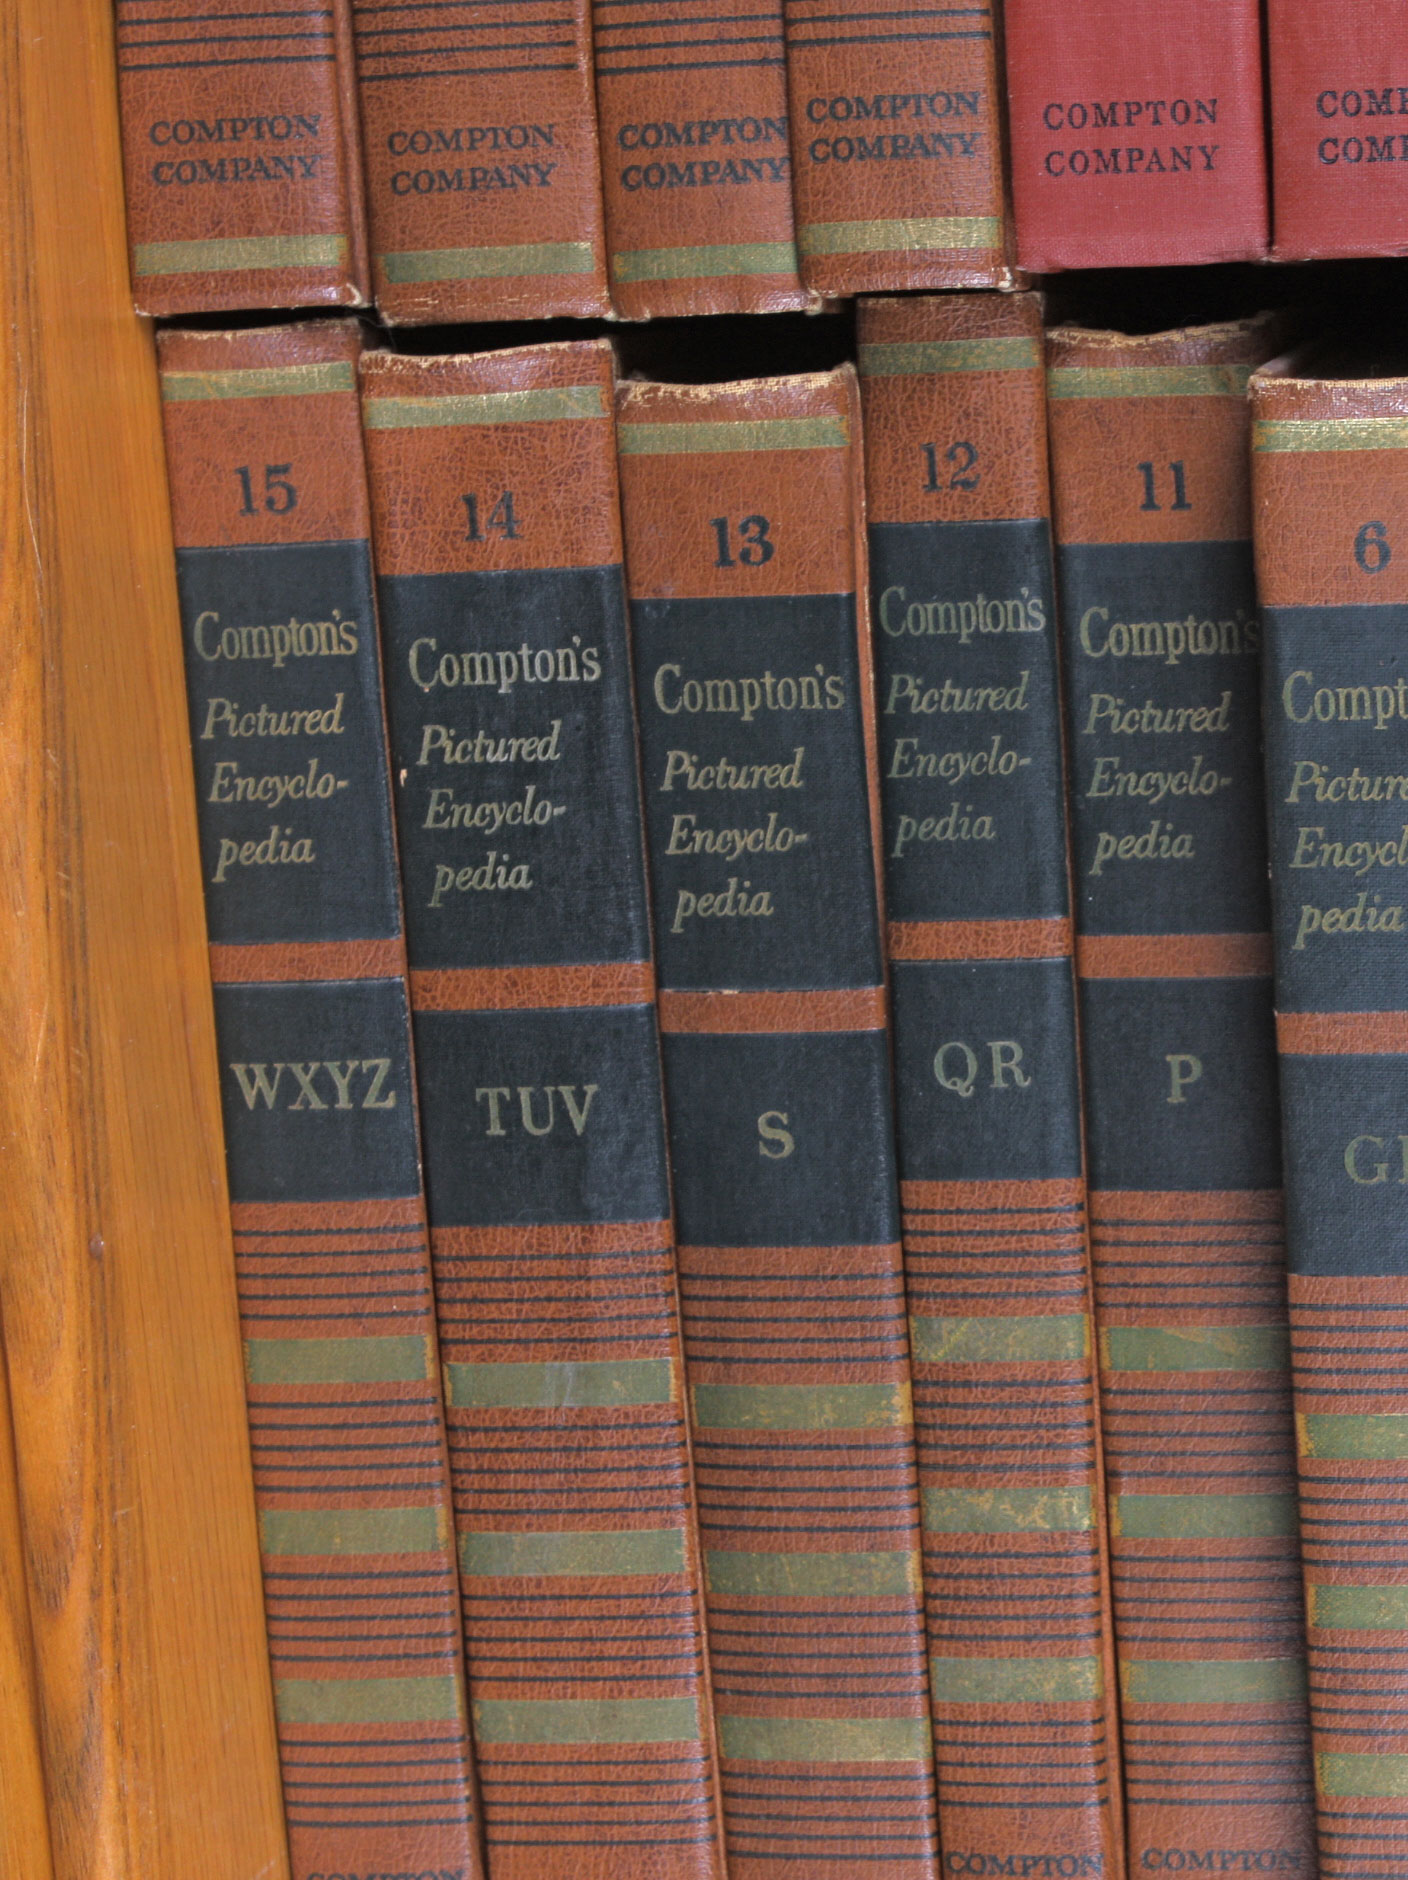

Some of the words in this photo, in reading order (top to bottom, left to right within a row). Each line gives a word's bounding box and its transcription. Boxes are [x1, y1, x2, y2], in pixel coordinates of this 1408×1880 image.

[148, 113, 321, 147] COMPTON
[805, 91, 981, 123] COMPTON
[1042, 98, 1219, 130] COMPTON
[387, 123, 555, 157] COMPTON
[617, 117, 788, 150] COMPTON
[808, 132, 982, 164] COMPANY
[152, 154, 320, 186] COMPANY
[390, 162, 557, 196] COMPANY
[621, 156, 791, 191] COMPANY
[1043, 144, 1220, 176] COMPANY
[235, 463, 297, 516] 15
[921, 441, 979, 492] 12
[1137, 461, 1193, 512] 11
[461, 490, 522, 541] 14
[709, 515, 774, 568] 13
[1353, 520, 1392, 575] 6
[194, 609, 358, 667] Compton's
[878, 586, 1046, 643] Compton's
[408, 636, 601, 692] Compton's
[653, 663, 844, 721] Compton's
[885, 671, 1029, 715] Pictured
[1083, 692, 1231, 735] Pictured
[201, 694, 344, 740] Pictured
[416, 721, 561, 765] Pictured
[888, 735, 1032, 785] Encyclo-
[208, 758, 348, 809] Encyclo-
[661, 748, 803, 792] Pictured
[1086, 756, 1232, 802] Encyclo-
[423, 786, 567, 833] Encyclo-
[892, 803, 995, 858] pedia
[212, 826, 315, 883] pedia
[666, 813, 807, 860] Encyclo-
[1090, 821, 1195, 875] pedia
[428, 853, 532, 907] pedia
[670, 879, 774, 933] pedia
[1292, 893, 1404, 949] pedia
[230, 1058, 395, 1111] WXYZ
[1166, 1054, 1202, 1104] P
[476, 1084, 598, 1136] TUV
[757, 1111, 795, 1160] S
[945, 1851, 1104, 1878] COMPTON
[1141, 1847, 1301, 1872] COMPTON
